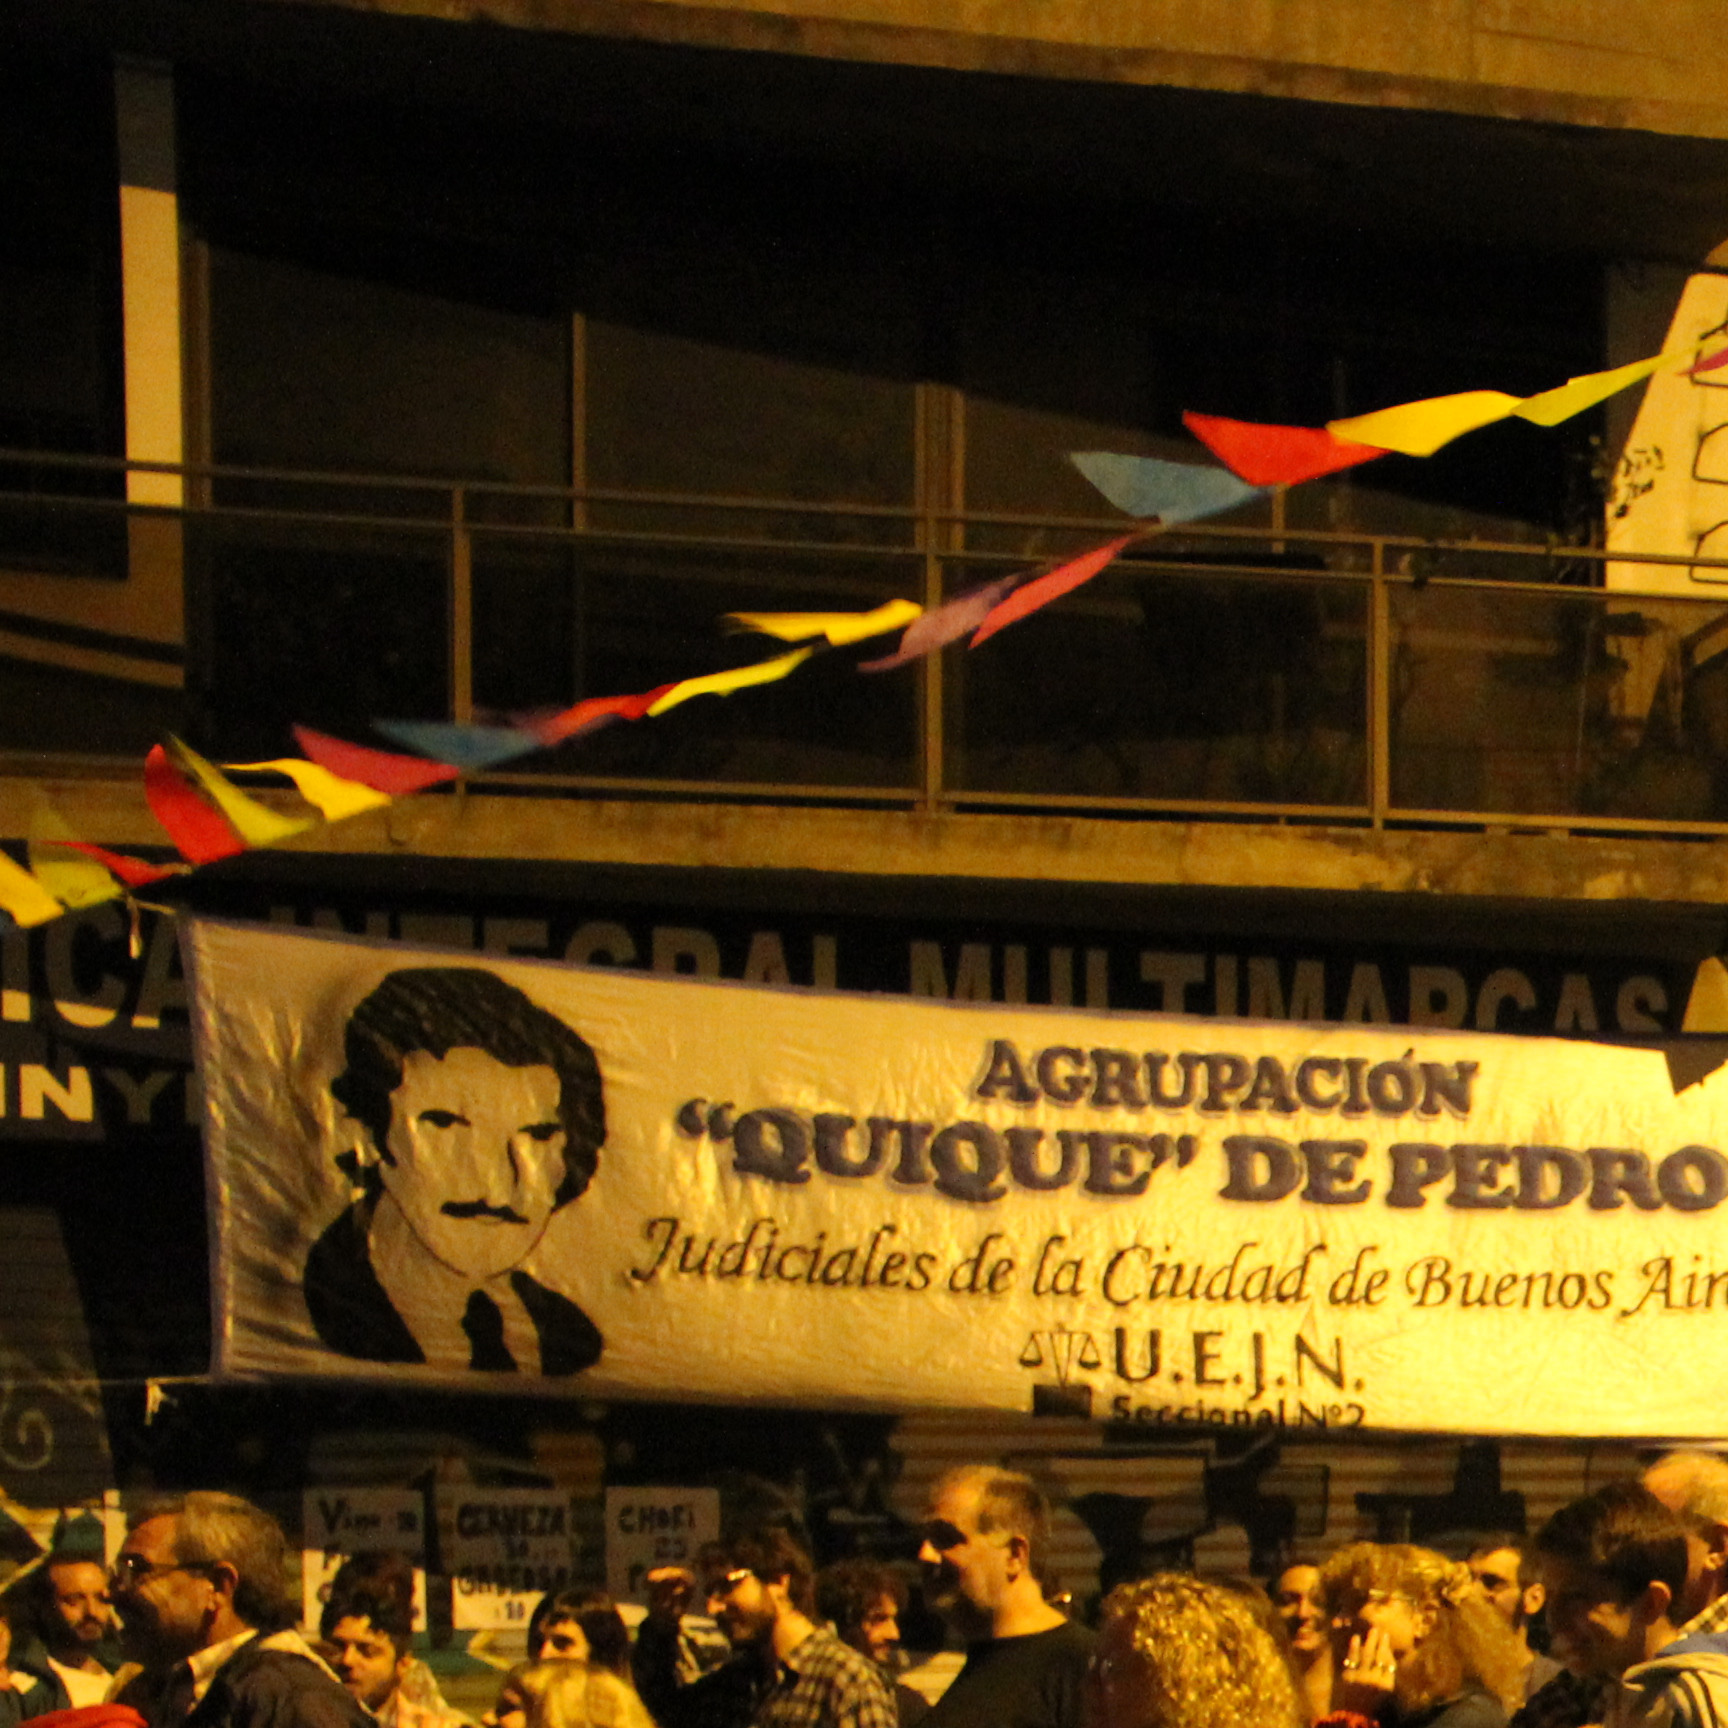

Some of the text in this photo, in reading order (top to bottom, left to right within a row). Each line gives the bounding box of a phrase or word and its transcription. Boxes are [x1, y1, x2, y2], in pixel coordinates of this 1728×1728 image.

[977, 1040, 1479, 1118] AGRUPACIÓN
[1221, 1135, 1375, 1205] DE
[628, 1216, 936, 1291] Judiciales
[948, 1234, 1014, 1295] de
[1032, 1235, 1086, 1297] la
[1102, 1241, 1324, 1307] Ciudad
[1330, 1245, 1390, 1308] de
[1406, 1254, 1614, 1311] Buenos
[1114, 1326, 1365, 1400] U.E.J.N.
